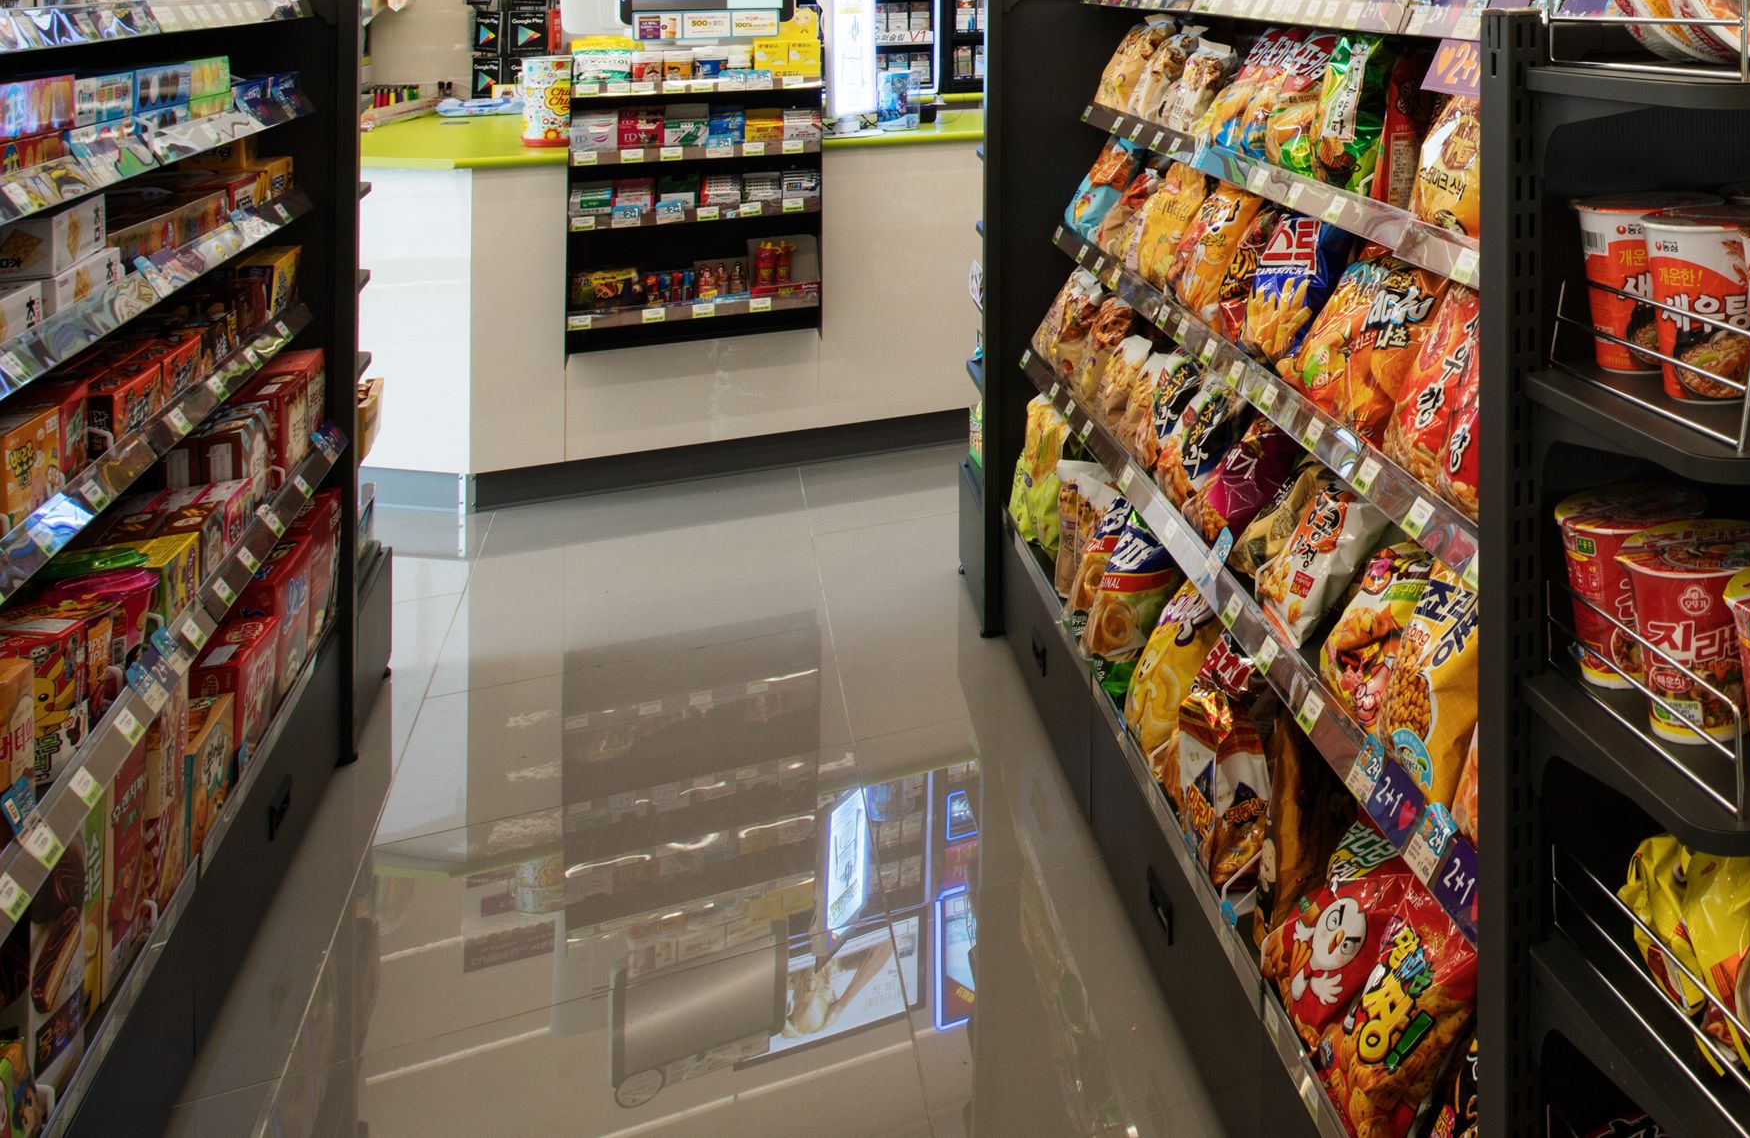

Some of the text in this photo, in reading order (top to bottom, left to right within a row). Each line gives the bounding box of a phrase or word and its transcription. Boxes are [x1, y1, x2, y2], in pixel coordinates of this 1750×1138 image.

[511, 18, 544, 26] Google Play
[1659, 268, 1702, 287] 개운한!
[1379, 776, 1405, 819] 2+1
[1429, 827, 1449, 855] 2+1
[1443, 858, 1476, 906] 2+1
